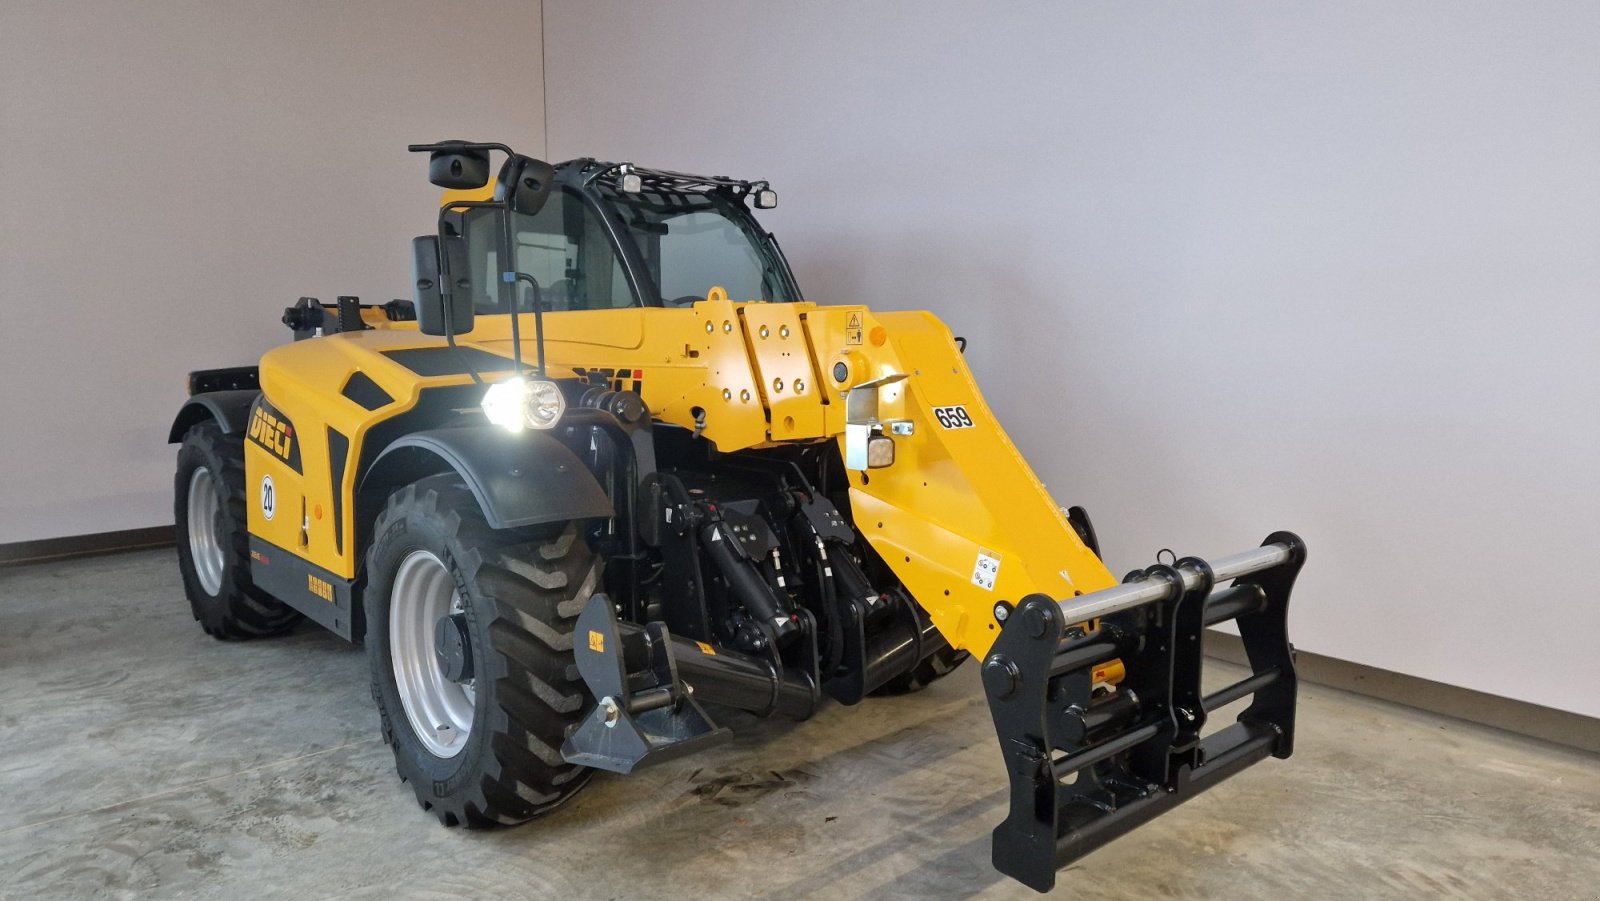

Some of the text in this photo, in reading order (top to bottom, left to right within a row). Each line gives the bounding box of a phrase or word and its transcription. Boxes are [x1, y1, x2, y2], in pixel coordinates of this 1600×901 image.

[935, 406, 973, 429] 659
[249, 406, 292, 460] DIECI
[263, 483, 273, 512] 20
